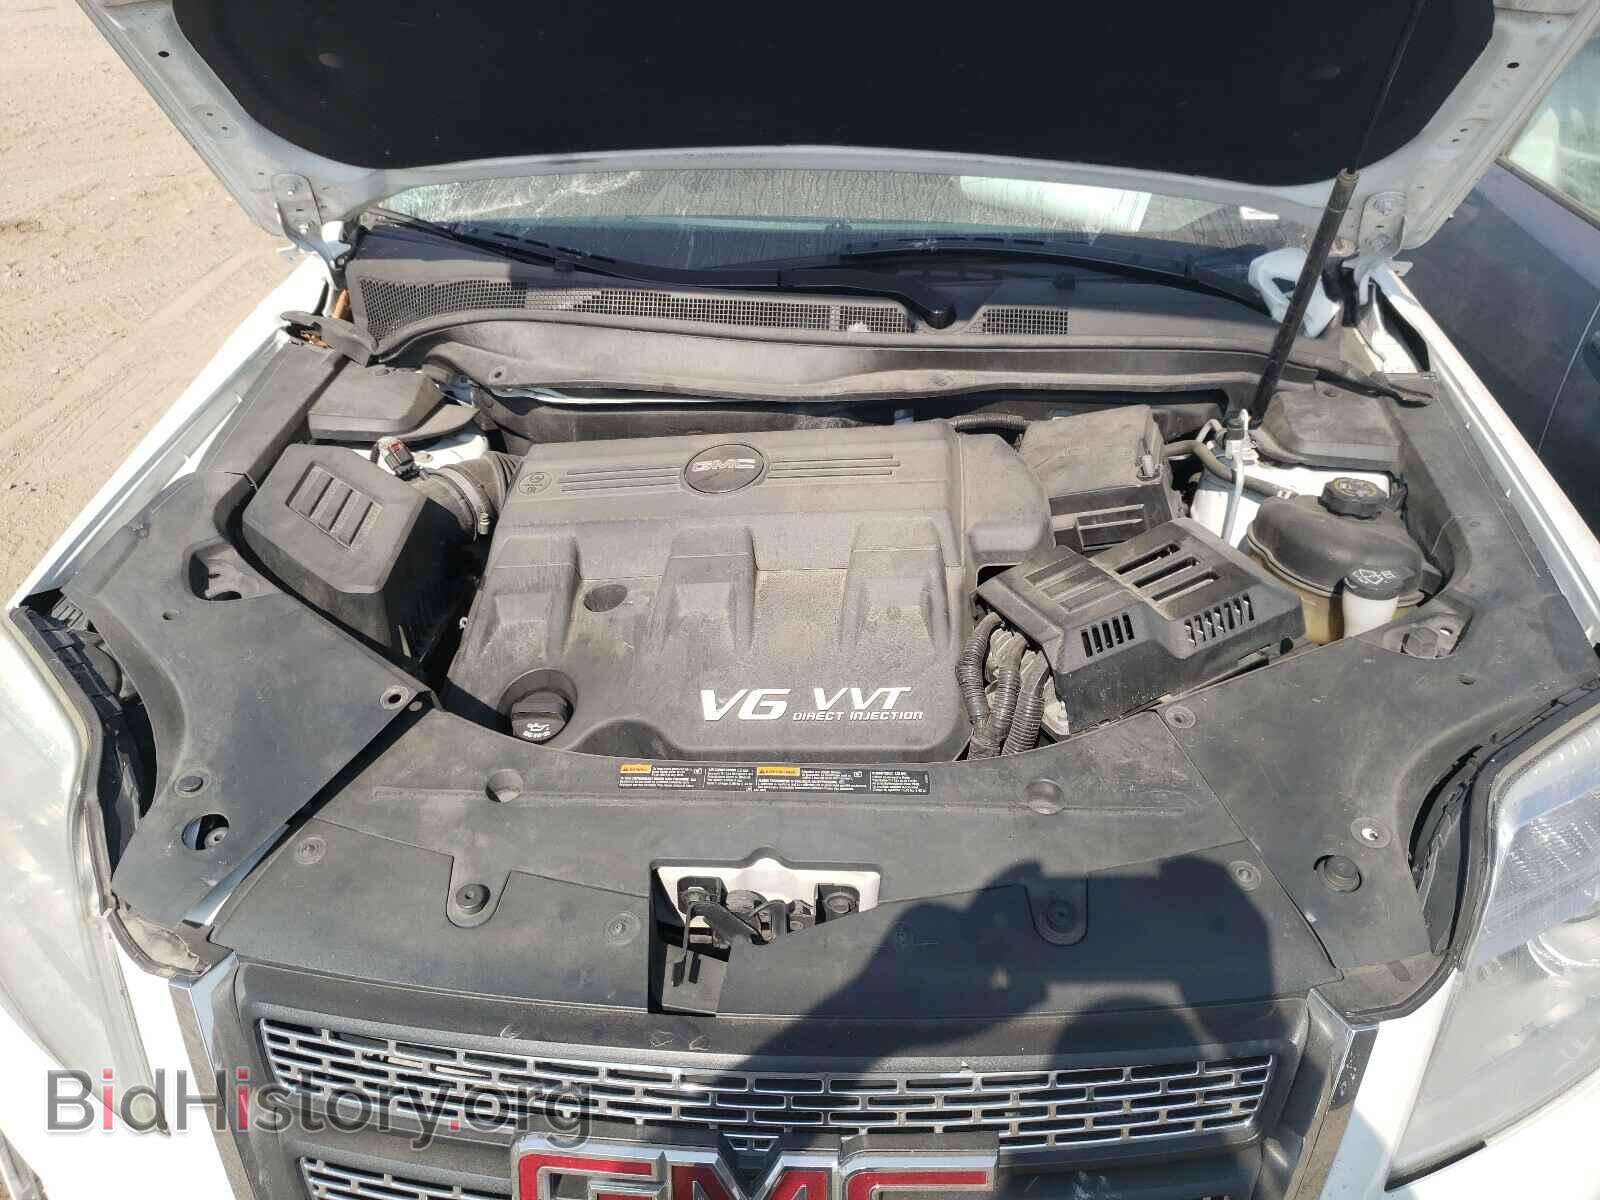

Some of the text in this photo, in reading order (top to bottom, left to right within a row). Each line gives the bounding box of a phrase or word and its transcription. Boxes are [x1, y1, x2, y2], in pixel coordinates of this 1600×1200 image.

[691, 458, 757, 473] GMC
[700, 688, 792, 721] V6
[813, 687, 913, 711] VVT
[792, 711, 924, 722] DIRECT INJECTION
